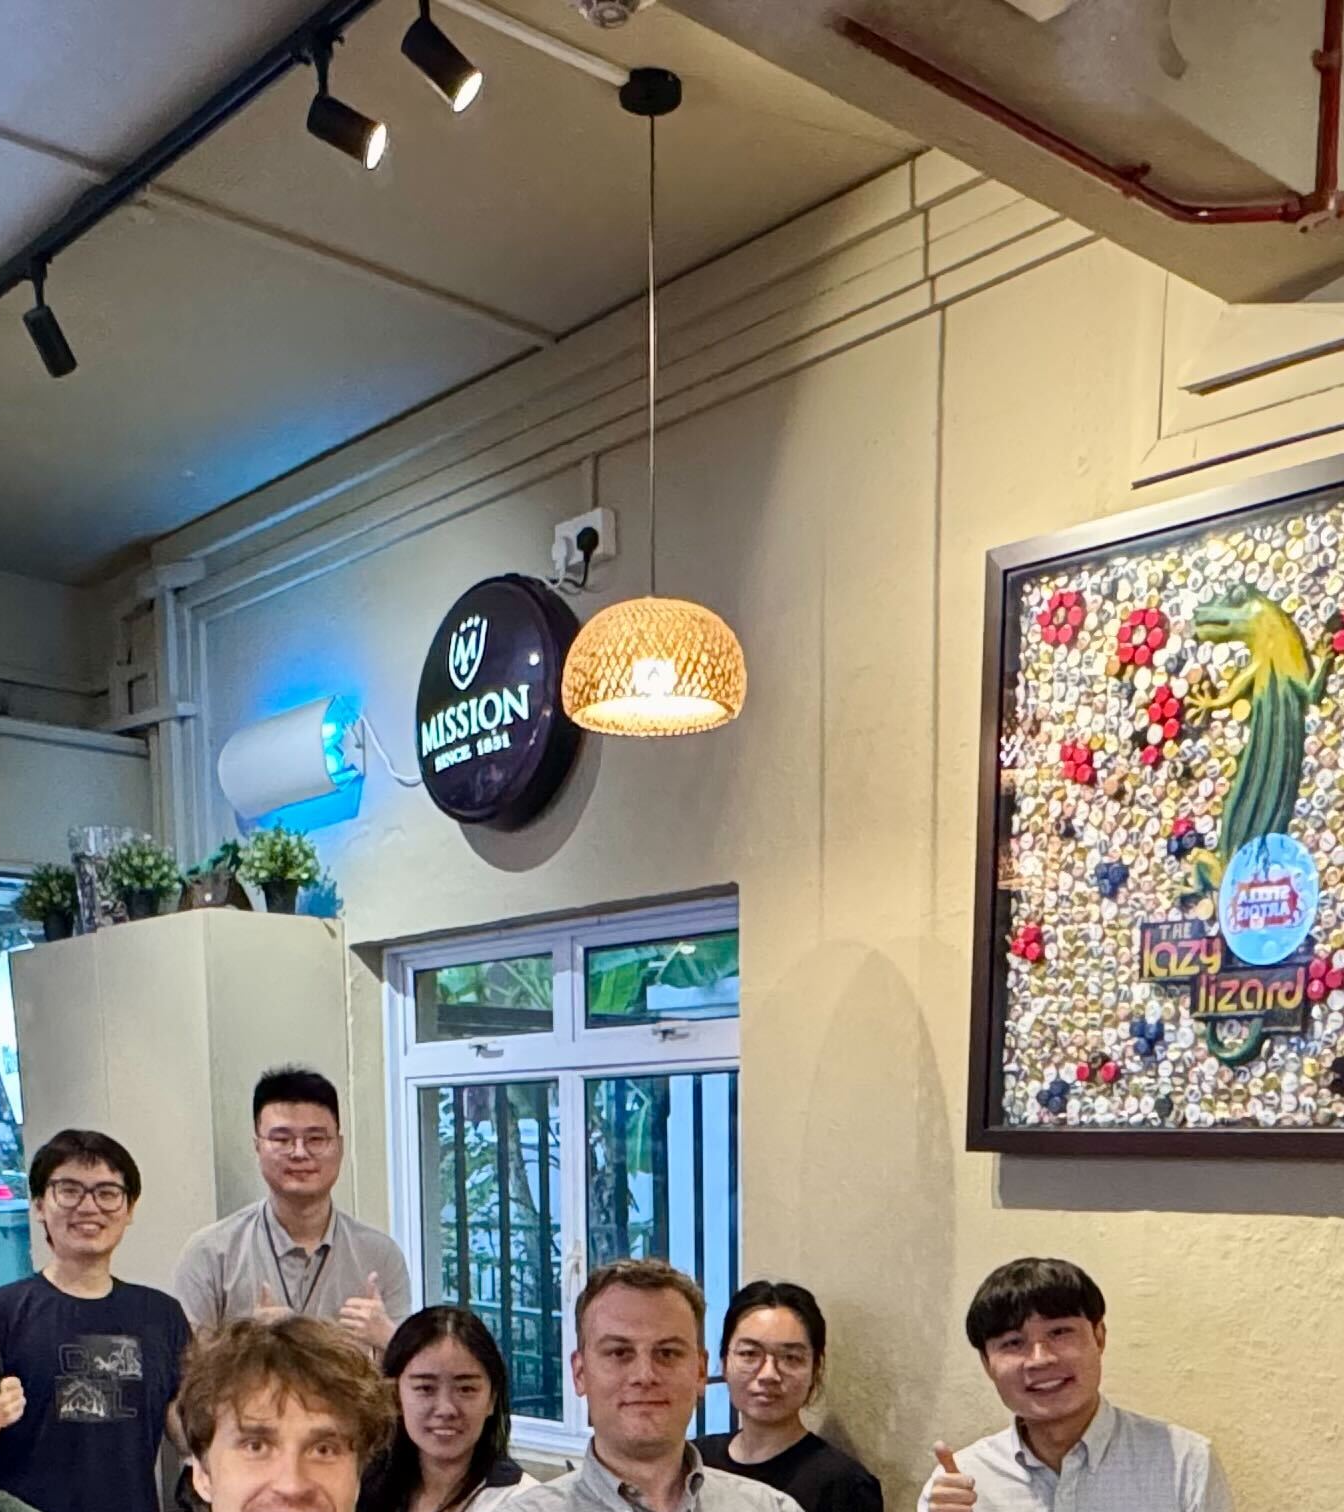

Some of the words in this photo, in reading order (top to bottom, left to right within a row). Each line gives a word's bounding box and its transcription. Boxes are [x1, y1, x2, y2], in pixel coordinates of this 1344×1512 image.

[421, 684, 530, 758] MISSION
[1142, 930, 1223, 978] lazy
[1159, 922, 1193, 940] THE
[1197, 967, 1306, 1013] lizard
